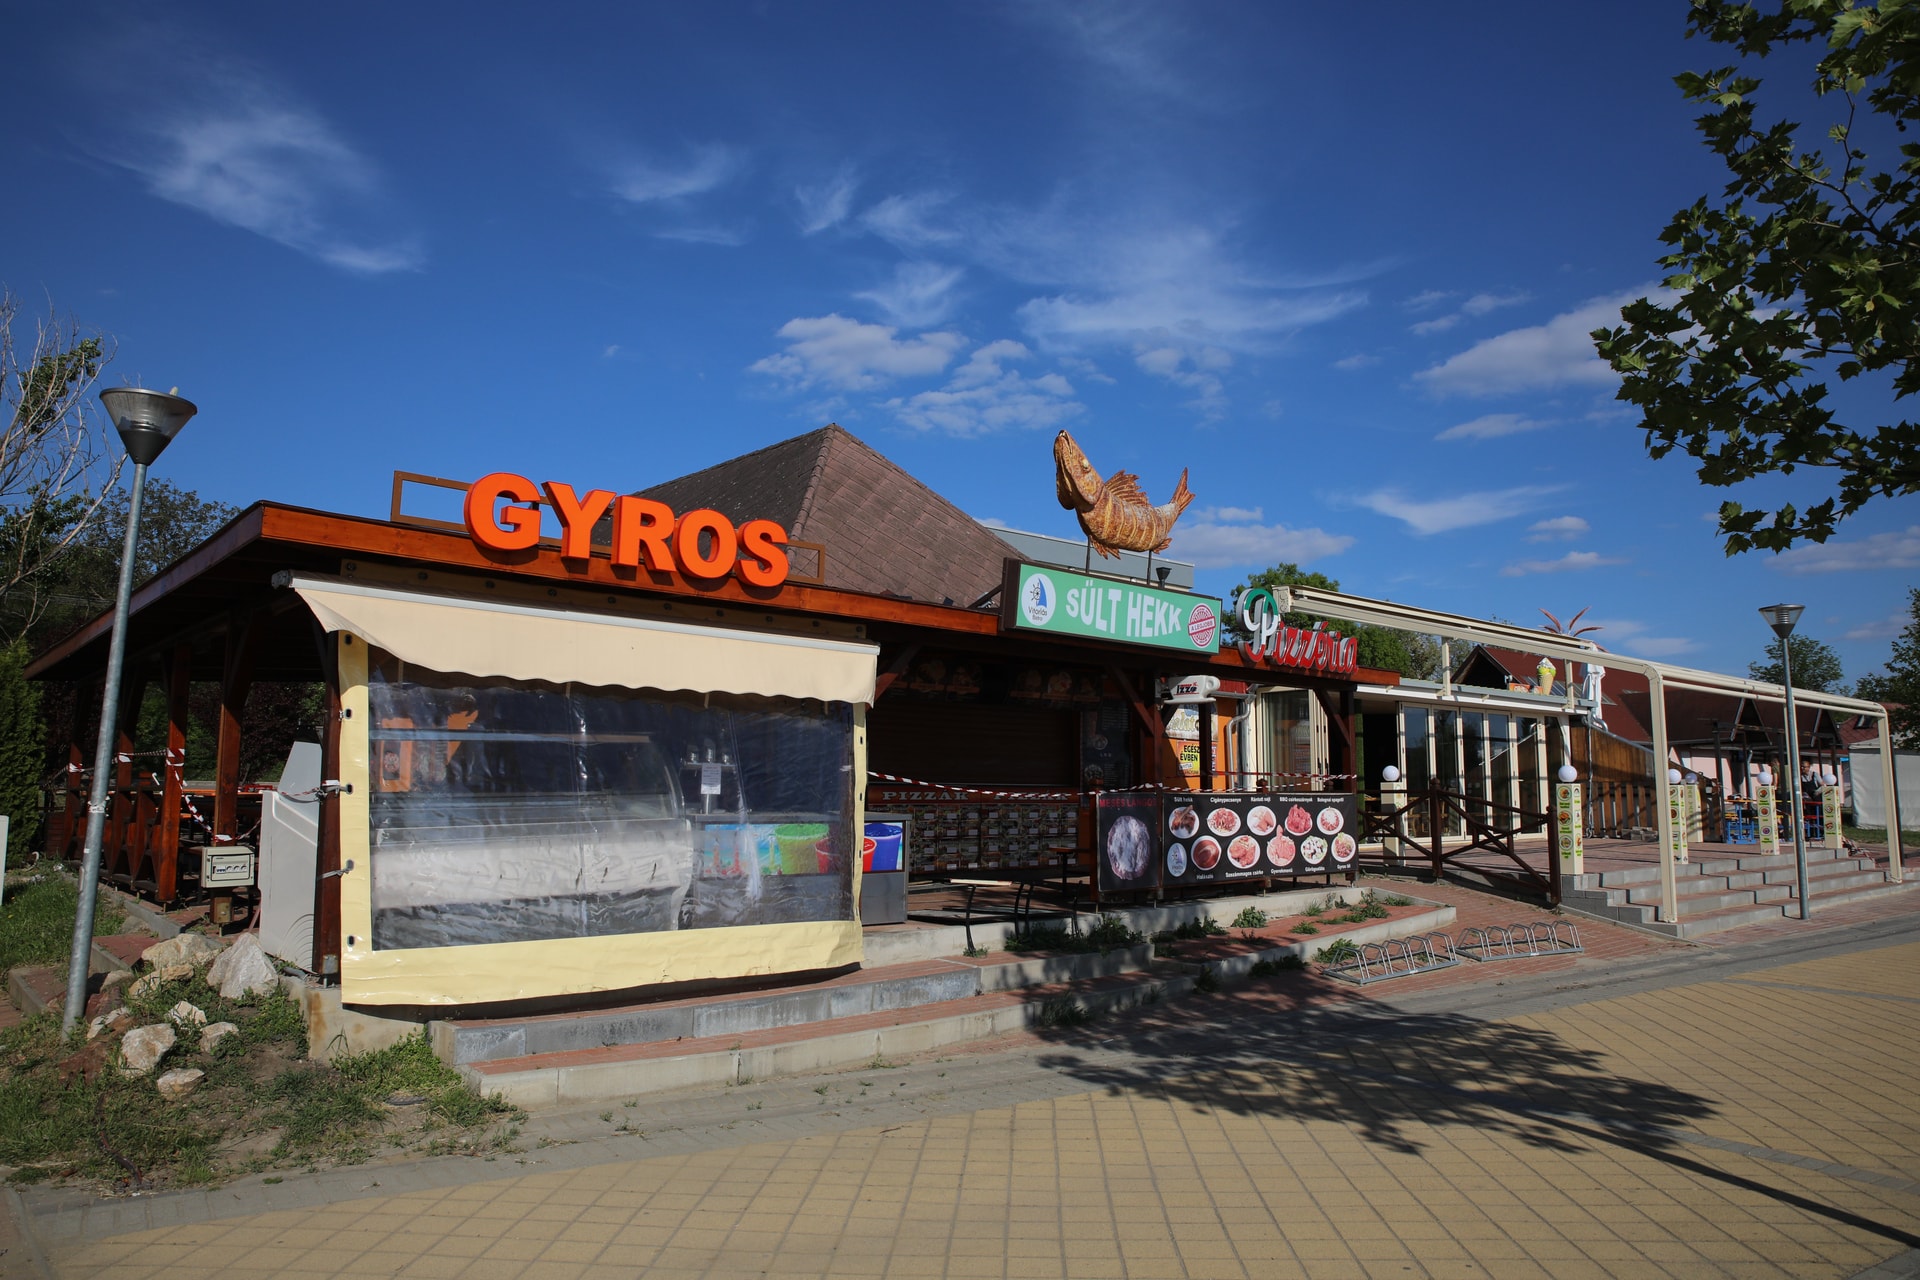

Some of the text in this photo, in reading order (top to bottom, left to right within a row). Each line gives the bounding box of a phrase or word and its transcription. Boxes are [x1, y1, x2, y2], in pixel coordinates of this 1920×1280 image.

[463, 472, 789, 587] GYROS
[1065, 580, 1182, 638] SÜLT HEKK
[1236, 587, 1358, 674] Pizzéria
[1180, 751, 1198, 762] ÉVBEN
[882, 789, 969, 801] PIZZÁK
